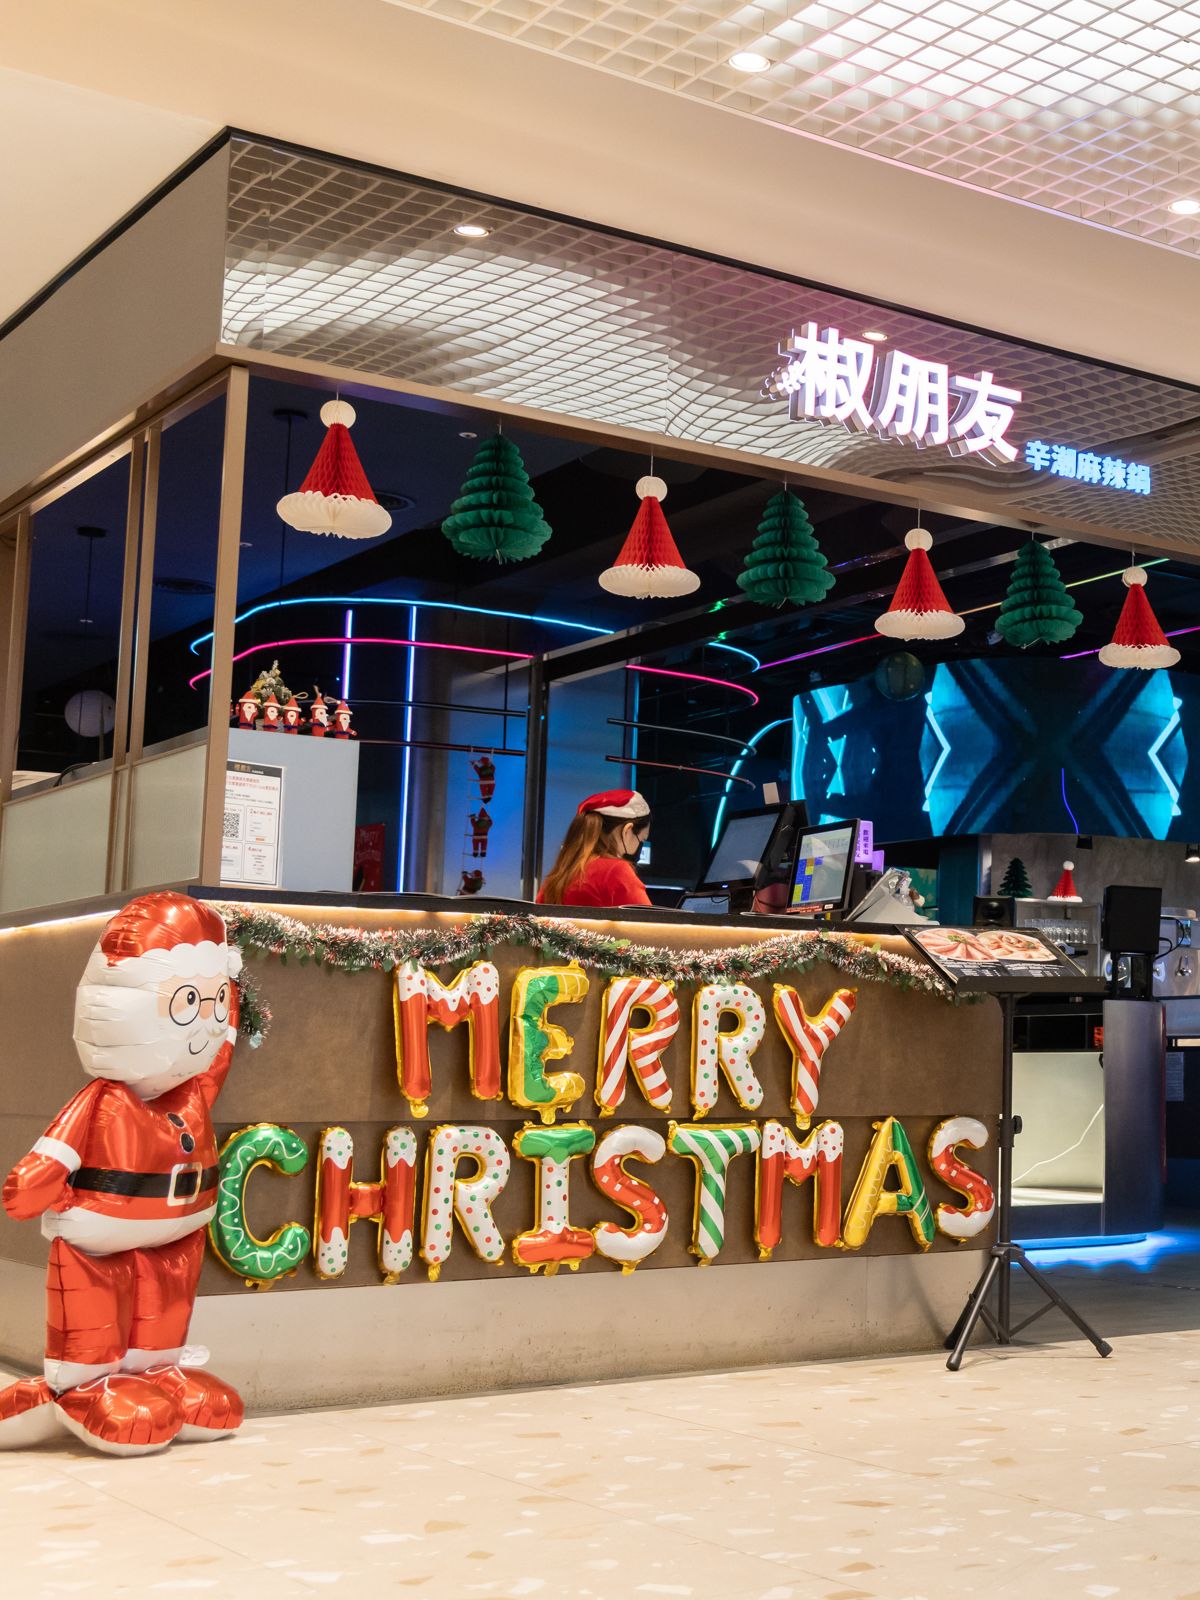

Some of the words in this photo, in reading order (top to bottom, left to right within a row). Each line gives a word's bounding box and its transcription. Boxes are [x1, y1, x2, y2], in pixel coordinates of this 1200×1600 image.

[785, 321, 1022, 463] 椒朋友
[1025, 440, 1151, 495] 辛潮麻辣鍋
[393, 960, 856, 1129] MERRY
[209, 1116, 996, 1290] CHRISTMAS
